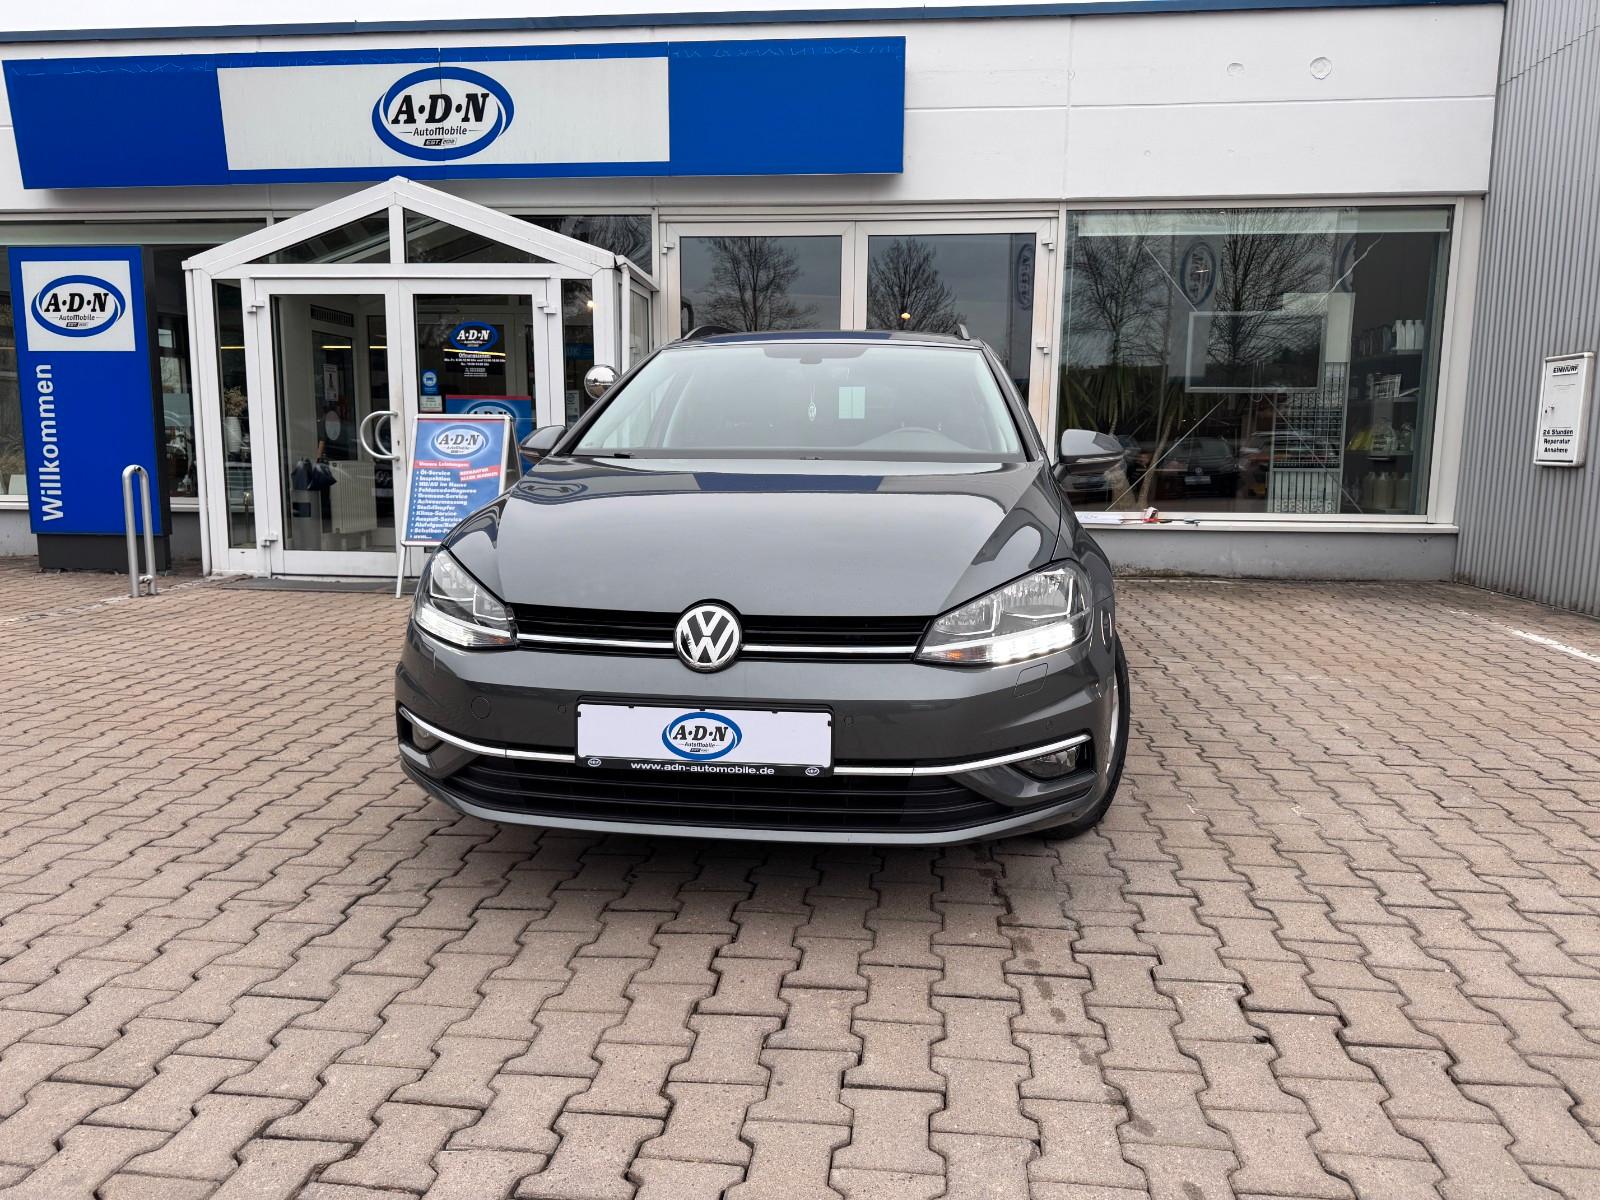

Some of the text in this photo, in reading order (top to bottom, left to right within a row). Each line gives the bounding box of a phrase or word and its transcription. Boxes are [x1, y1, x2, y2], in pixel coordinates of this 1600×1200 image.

[35, 364, 64, 521] Willkommen
[1543, 438, 1571, 446] Reparatur
[631, 762, 775, 775] www.adn-automobile.de
